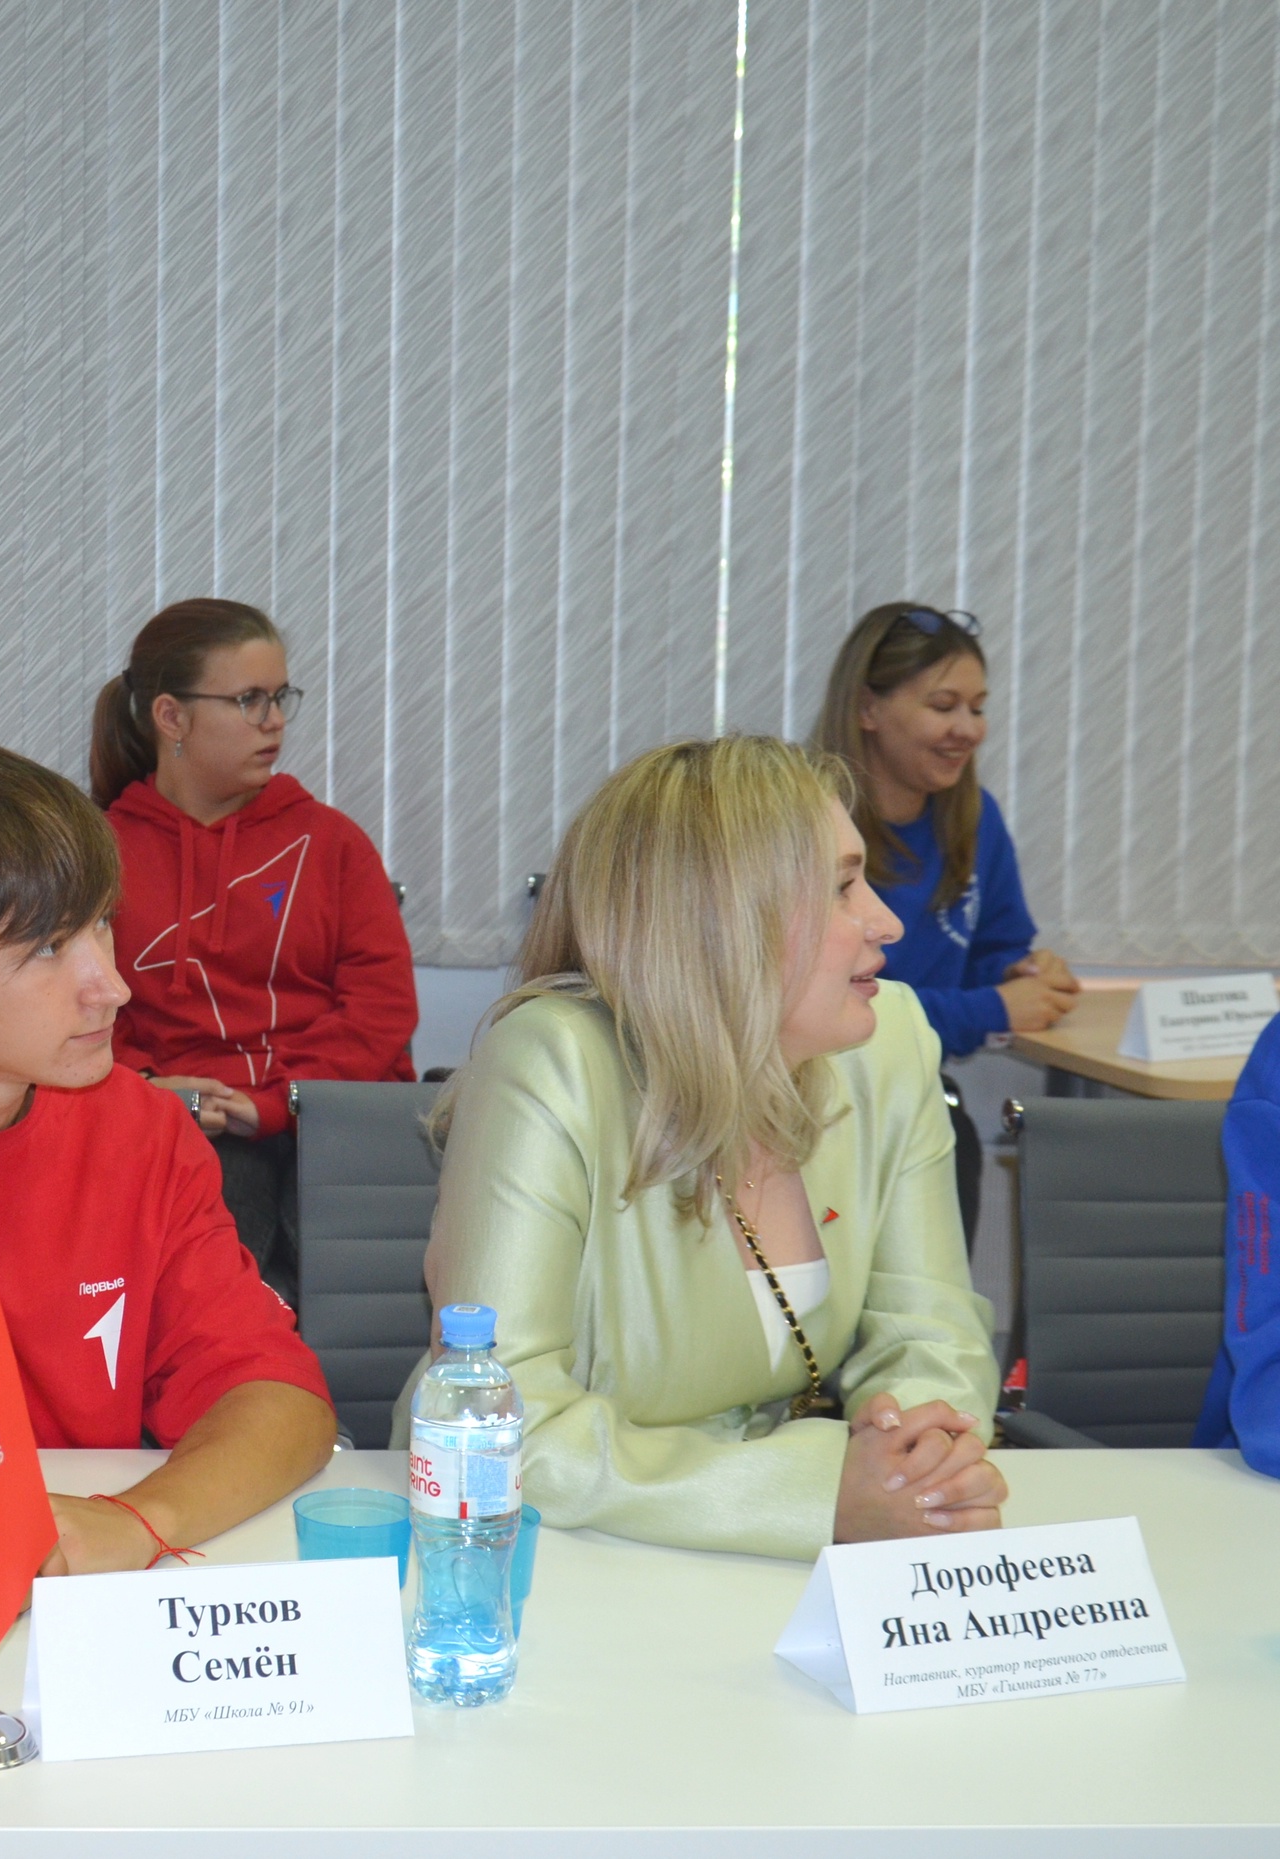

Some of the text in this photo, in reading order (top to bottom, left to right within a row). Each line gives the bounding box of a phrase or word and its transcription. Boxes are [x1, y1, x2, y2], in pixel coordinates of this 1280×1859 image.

[78, 1276, 125, 1297] Первые
[409, 1451, 433, 1476] aint
[409, 1471, 441, 1497] RING
[909, 1552, 1096, 1601] Дорофеева
[158, 1596, 302, 1638] Турков
[881, 1597, 1150, 1649] Яна Андреевна
[172, 1646, 299, 1683] Семён
[883, 1641, 1169, 1688] Наставник, куратор первичного отделения
[956, 1667, 1108, 1700] МБУ «Гимназия № 77»
[164, 1700, 315, 1724] МБУ «Школа № 91»
